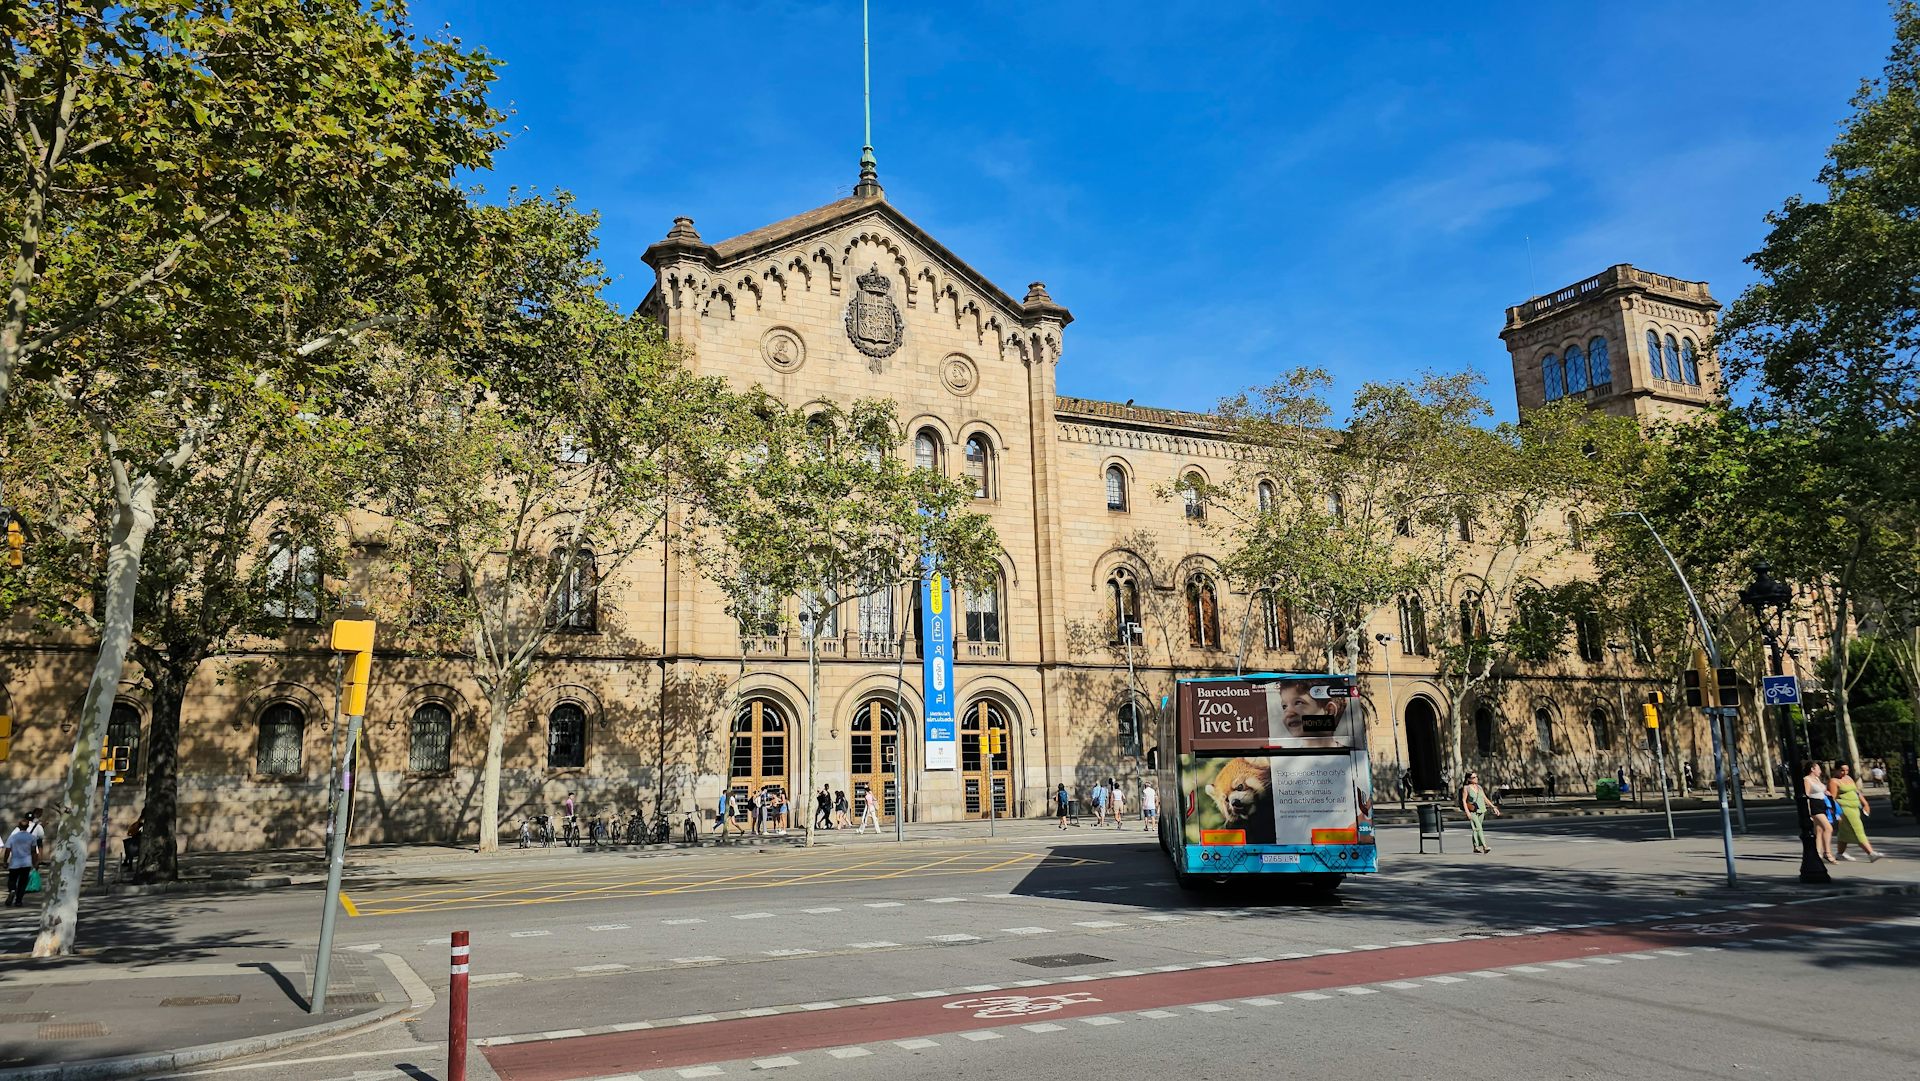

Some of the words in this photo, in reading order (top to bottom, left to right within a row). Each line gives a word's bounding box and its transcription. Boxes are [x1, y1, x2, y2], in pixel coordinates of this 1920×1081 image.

[935, 645, 942, 655] Jo
[1197, 686, 1251, 698] Barcelona
[935, 694, 943, 704] Tu
[1198, 699, 1238, 717] Zoo,
[1200, 716, 1232, 734] live
[1236, 716, 1254, 733] it!
[1277, 770, 1315, 778] Experience
[1328, 769, 1346, 777] city's
[1326, 796, 1335, 804] for
